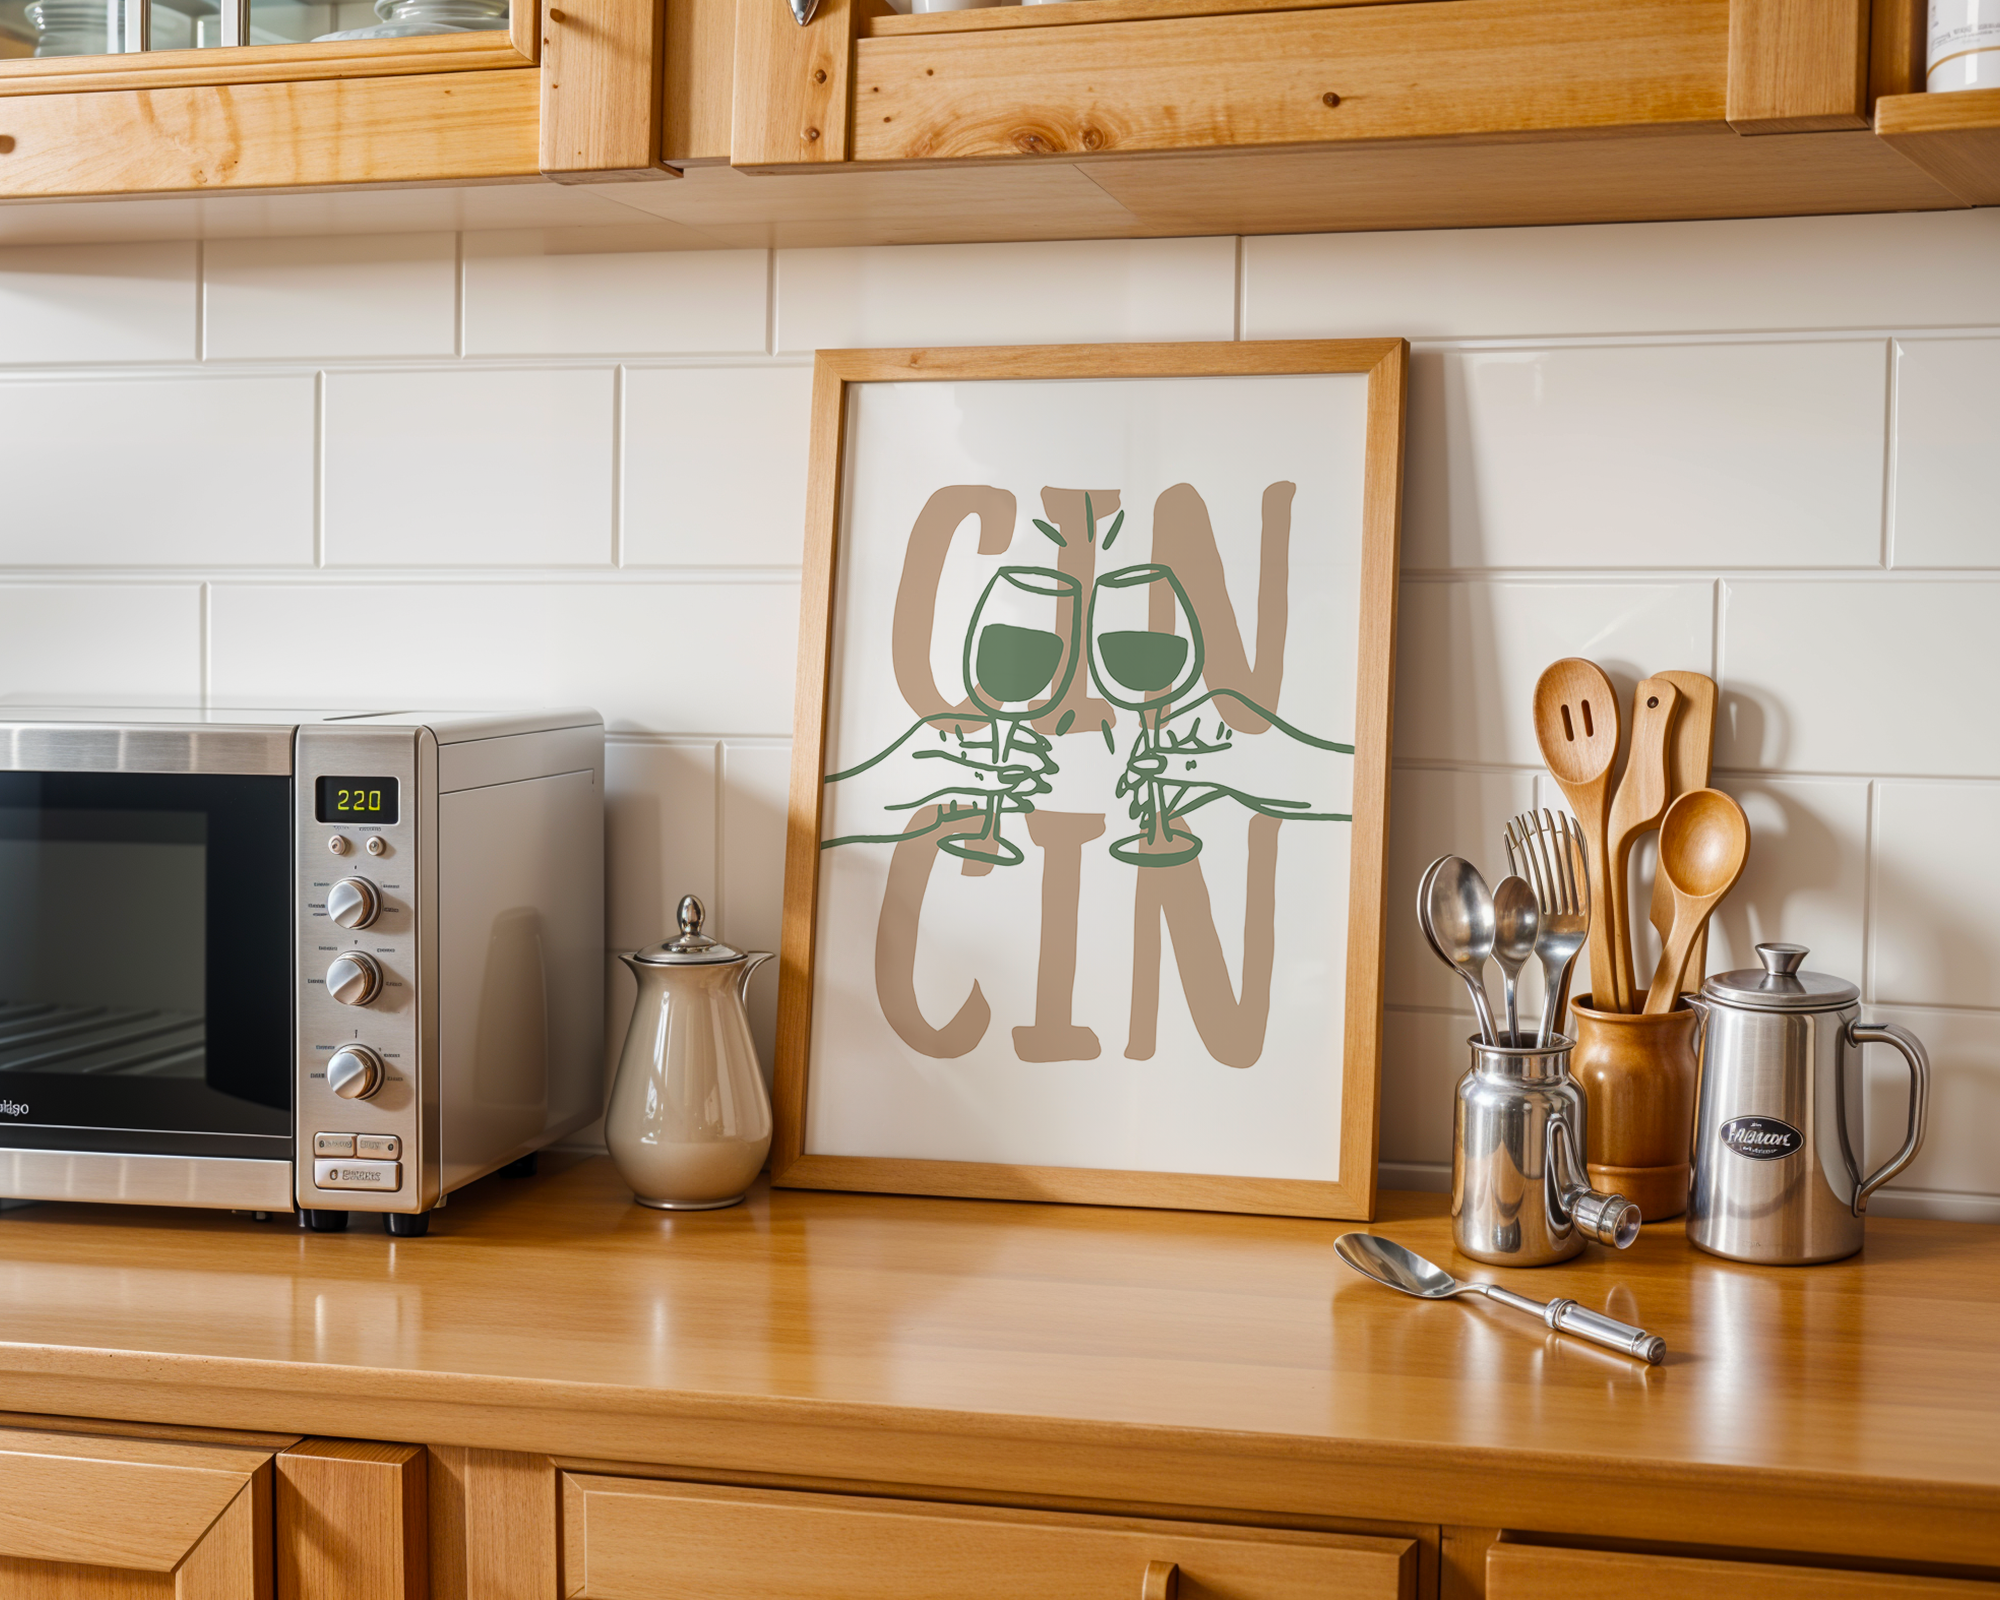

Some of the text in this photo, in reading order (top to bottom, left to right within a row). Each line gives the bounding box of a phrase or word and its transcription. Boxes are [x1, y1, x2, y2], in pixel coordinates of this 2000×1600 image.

[891, 480, 1297, 736] CIN
[337, 789, 381, 811] 220
[874, 802, 1285, 1069] CIN
